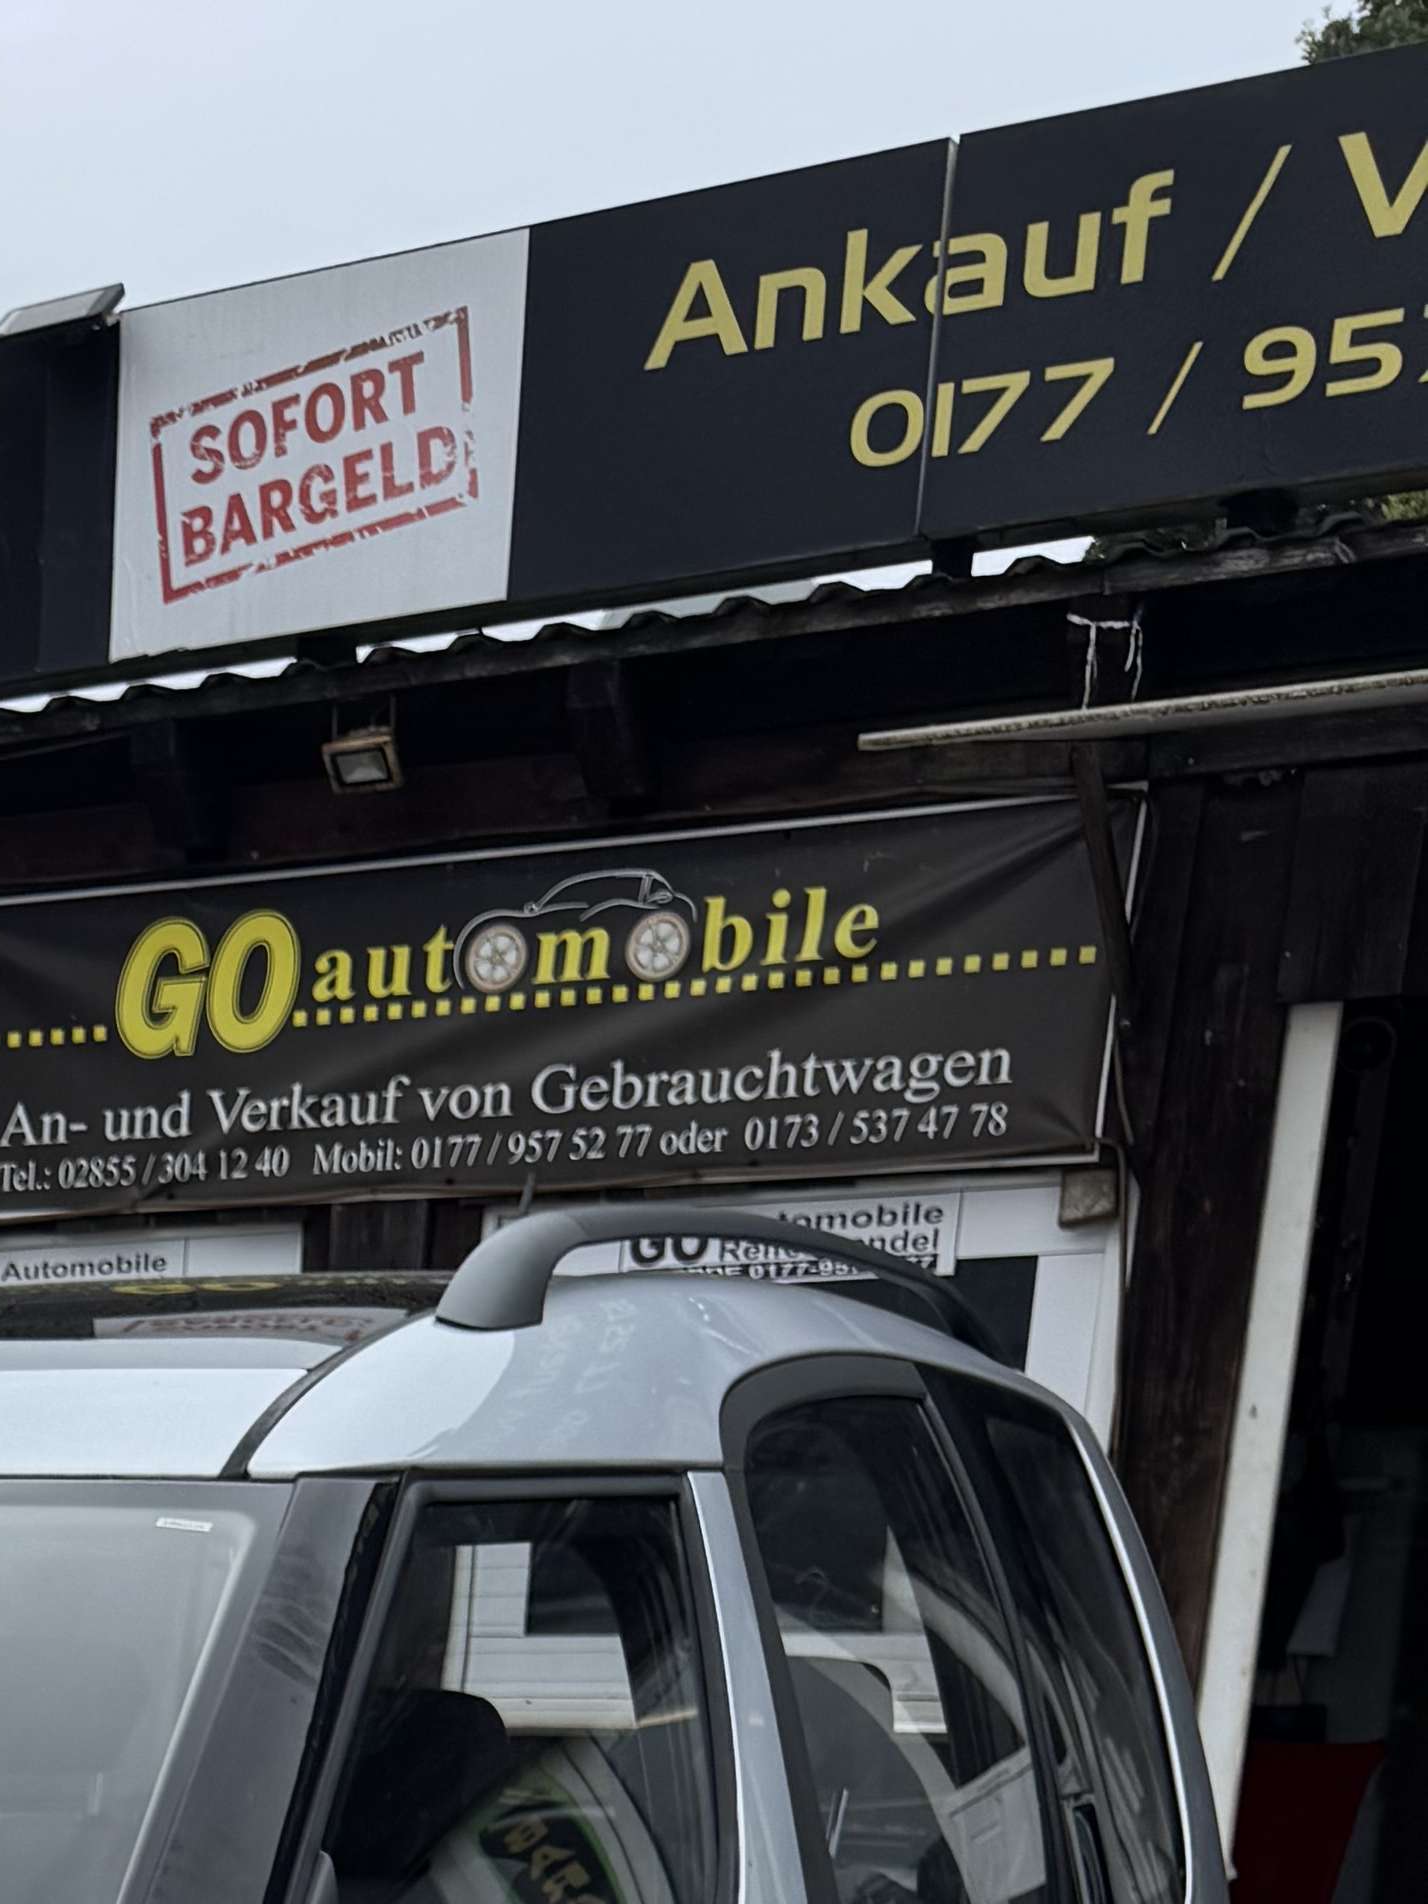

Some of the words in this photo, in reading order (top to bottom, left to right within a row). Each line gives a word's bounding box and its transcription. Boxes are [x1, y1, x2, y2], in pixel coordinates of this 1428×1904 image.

[643, 168, 1176, 372] Ankauf
[190, 351, 424, 485] SOFORT
[849, 357, 1115, 467] 0177
[1242, 303, 1428, 411] 95
[181, 425, 456, 567] BARGELD
[114, 906, 301, 1061] GO
[57, 1153, 137, 1190] 02855
[157, 1148, 208, 1185] 304
[217, 1147, 247, 1181] 12
[254, 1144, 290, 1180] 40
[312, 1136, 404, 1177] Mobil:
[411, 1132, 482, 1170] 0177
[507, 1127, 563, 1165] 957
[568, 1125, 606, 1161] 52
[616, 1122, 654, 1159] 77
[659, 1119, 729, 1157] oder
[744, 1112, 821, 1151] 0173
[850, 1106, 910, 1145] 537
[917, 1104, 960, 1141] 47
[970, 1100, 1010, 1138] 78
[104, 1089, 192, 1143] und
[207, 1074, 410, 1136] Verkauf
[418, 1079, 513, 1121] von
[530, 1046, 1012, 1115] Gebrauchtwagen
[0, 1251, 168, 1282] Automobile
